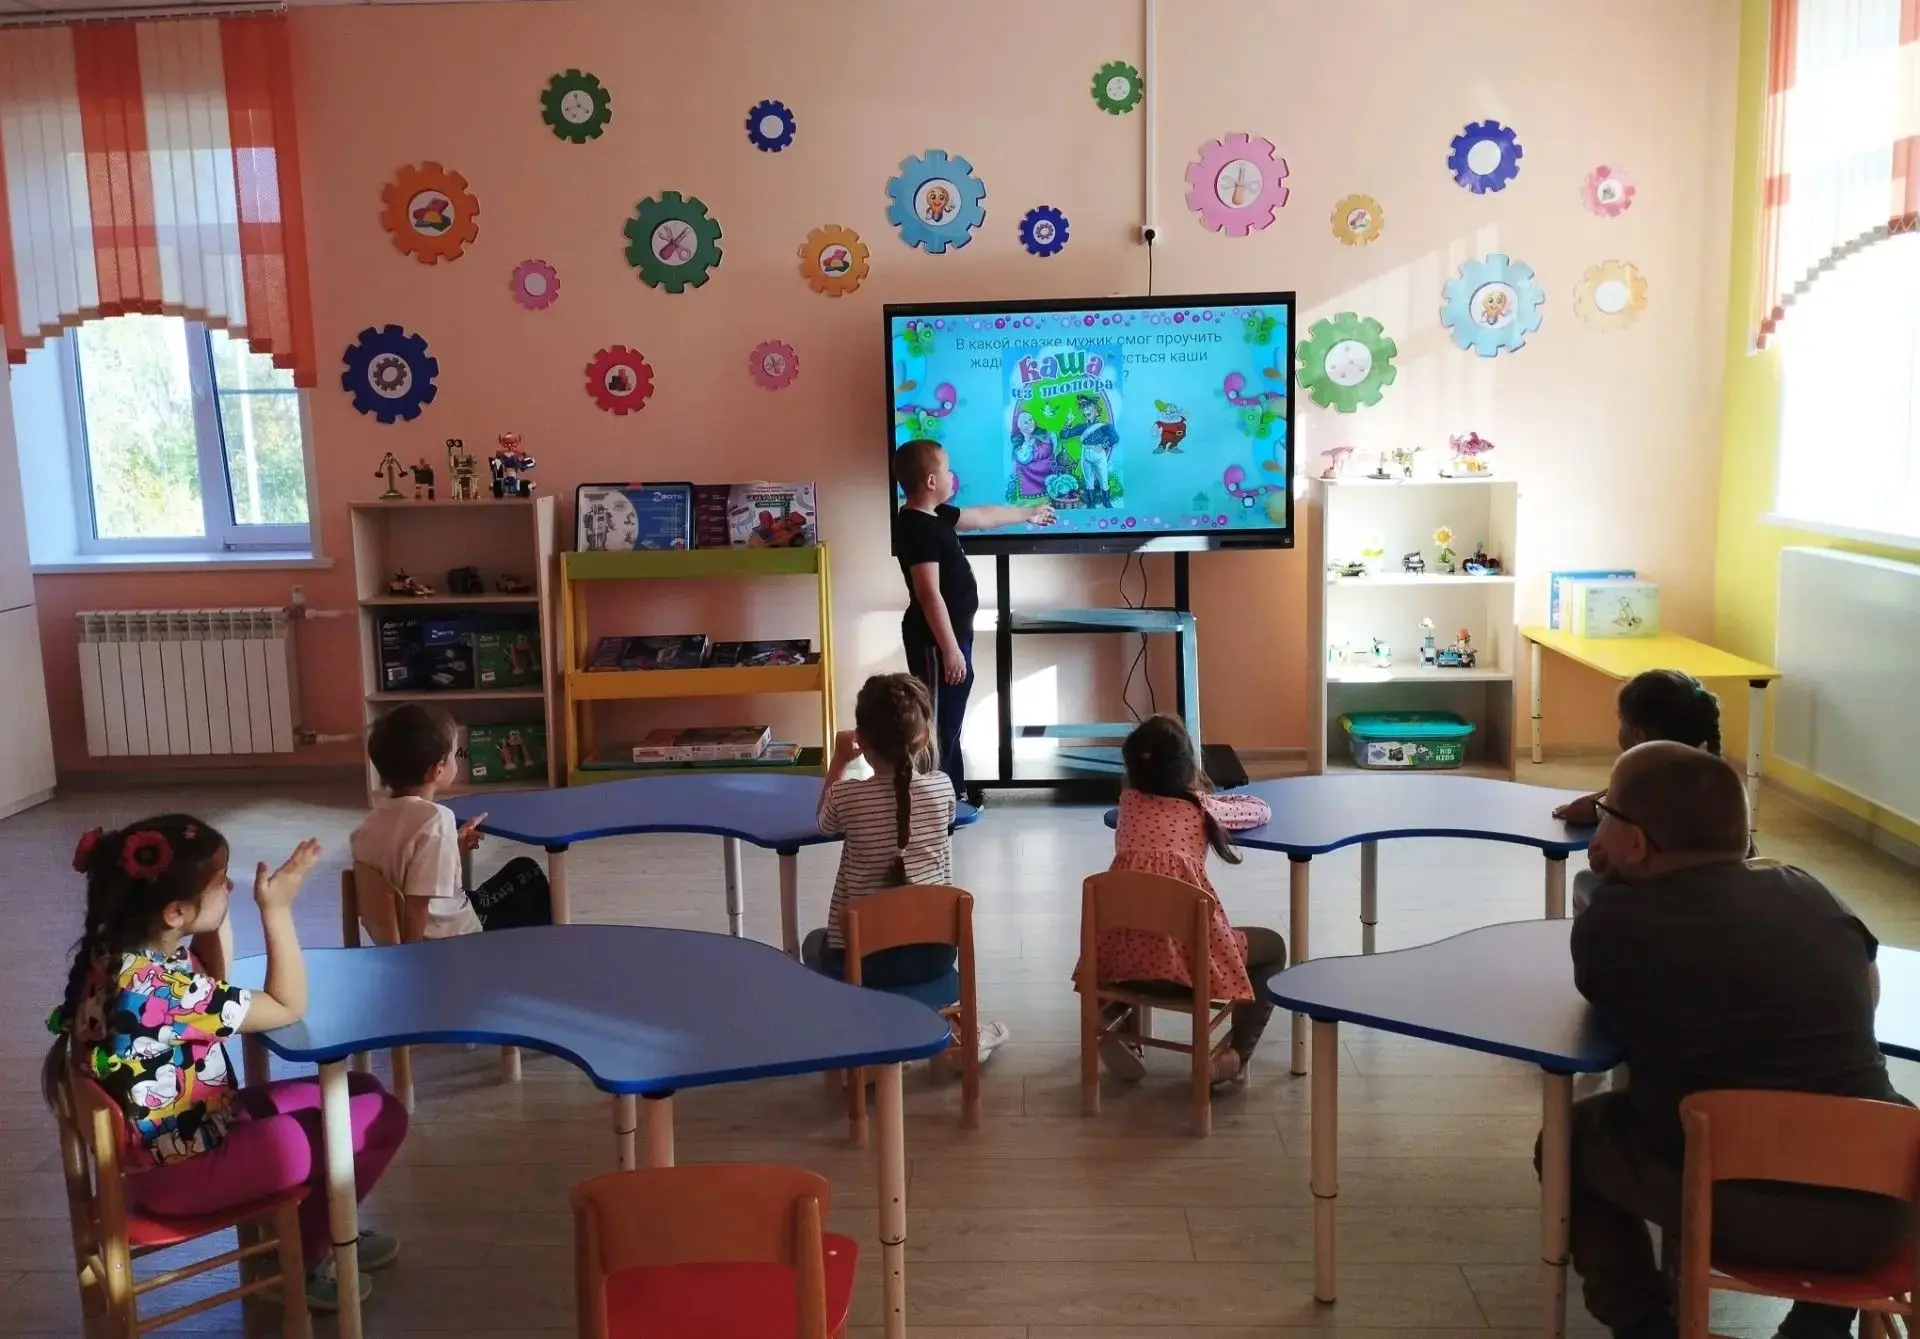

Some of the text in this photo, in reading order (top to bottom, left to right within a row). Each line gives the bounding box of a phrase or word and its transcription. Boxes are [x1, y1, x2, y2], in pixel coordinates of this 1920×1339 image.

[955, 331, 1223, 350] В какой сказке мужик смог проучить
[970, 357, 1002, 371] жад
[1170, 350, 1209, 362] каши
[1010, 377, 1114, 400] из топора
